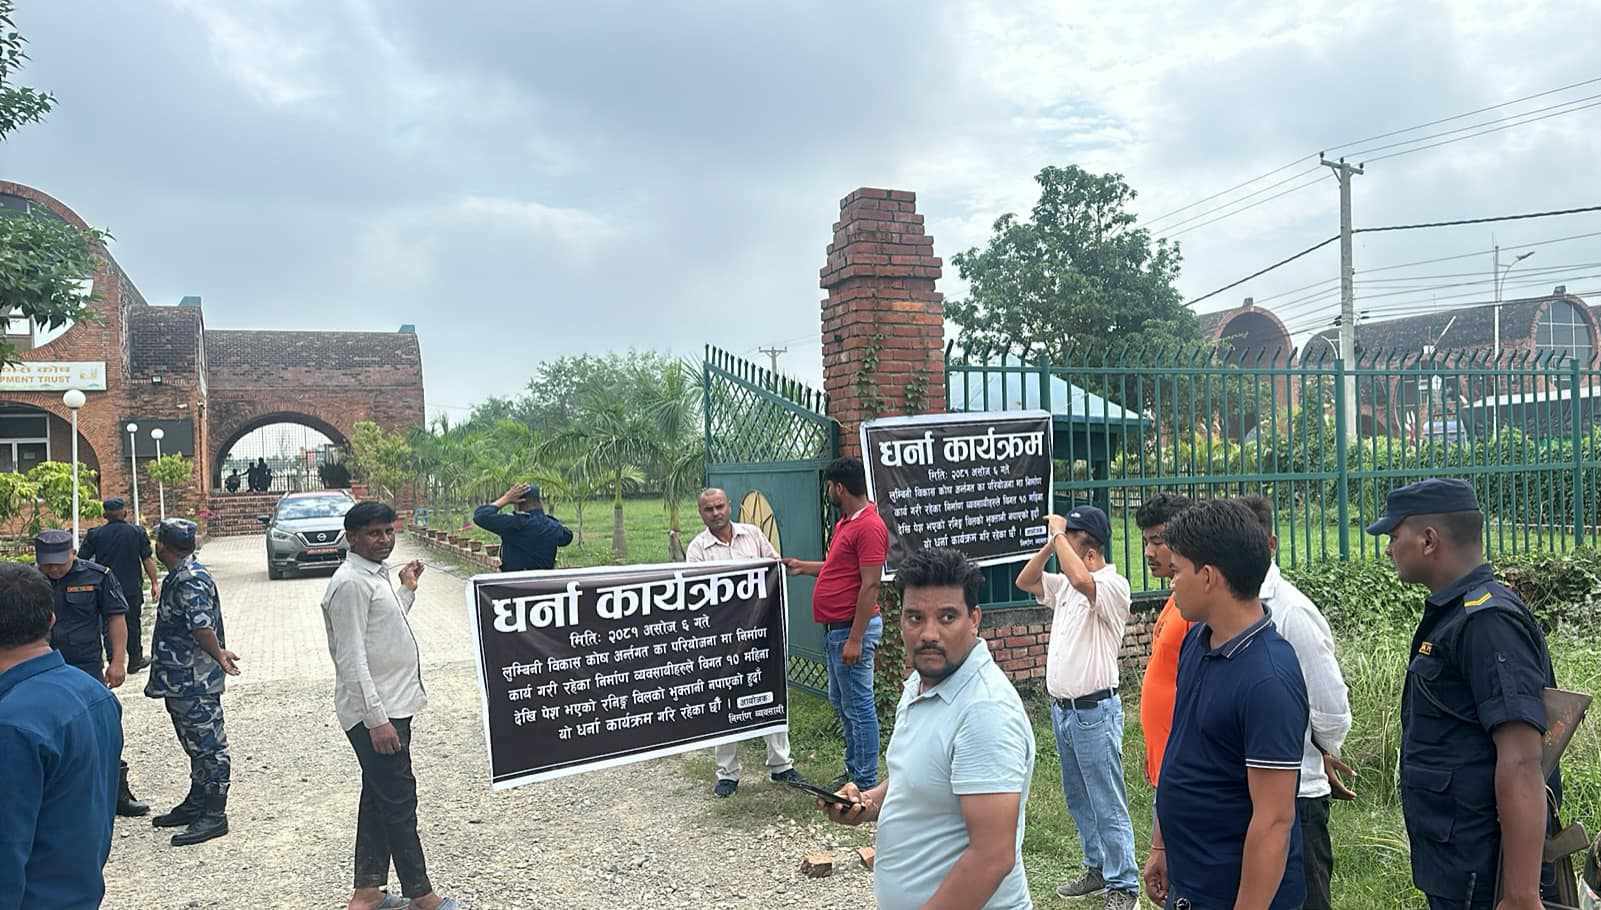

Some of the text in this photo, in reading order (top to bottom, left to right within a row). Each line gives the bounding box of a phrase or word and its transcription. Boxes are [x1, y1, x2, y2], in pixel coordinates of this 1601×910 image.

[879, 428, 1044, 467] धर्ना कार्यक्रम
[491, 567, 768, 633] धर्ना कार्यक्रम
[547, 657, 581, 672] विकास
[585, 651, 609, 665] कोष
[653, 643, 667, 654] का
[671, 635, 717, 652] परियोजना
[721, 633, 732, 643] मा
[736, 626, 767, 642] निर्माण
[609, 627, 638, 643] २०८१
[644, 620, 676, 636] असोज
[682, 620, 689, 631] ६
[694, 614, 710, 629] गते
[508, 684, 532, 700] कार्य
[537, 680, 558, 697] गरी
[562, 679, 591, 695] रहेका
[595, 670, 630, 688] निर्माण
[698, 656, 722, 670] विगत
[727, 654, 739, 665] १०
[744, 647, 769, 662] महिना
[514, 708, 537, 726] देखि
[541, 706, 560, 719] पेश
[564, 699, 597, 717] भएको
[669, 679, 704, 701] भुक्तानी
[708, 673, 743, 690] नपाएको
[559, 725, 572, 739] यो
[576, 717, 600, 736] धर्ना
[606, 712, 653, 731] कार्यक्रम
[657, 706, 676, 721] गरि
[680, 704, 705, 719] रहेका
